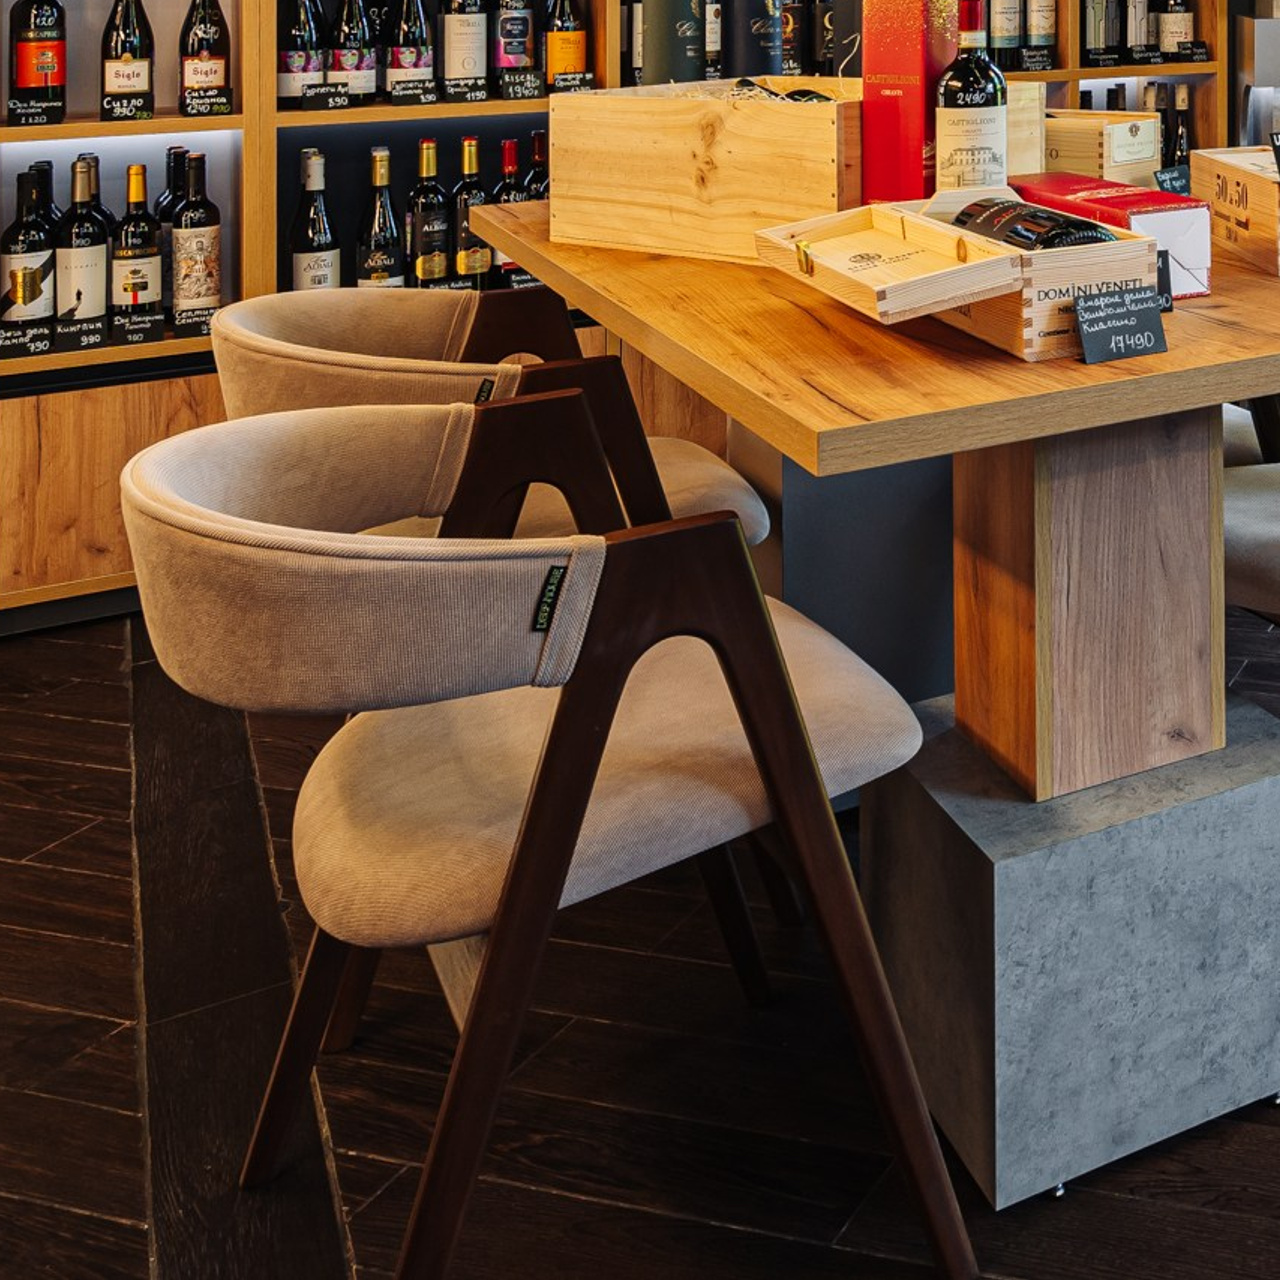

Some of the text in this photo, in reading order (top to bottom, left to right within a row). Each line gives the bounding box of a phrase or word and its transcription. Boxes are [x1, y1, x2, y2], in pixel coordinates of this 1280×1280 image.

[866, 74, 920, 86] CASTIGLIONI
[957, 92, 987, 105] 2490
[946, 116, 997, 128] CASTIGLIONI
[1108, 331, 1155, 354] 17490
